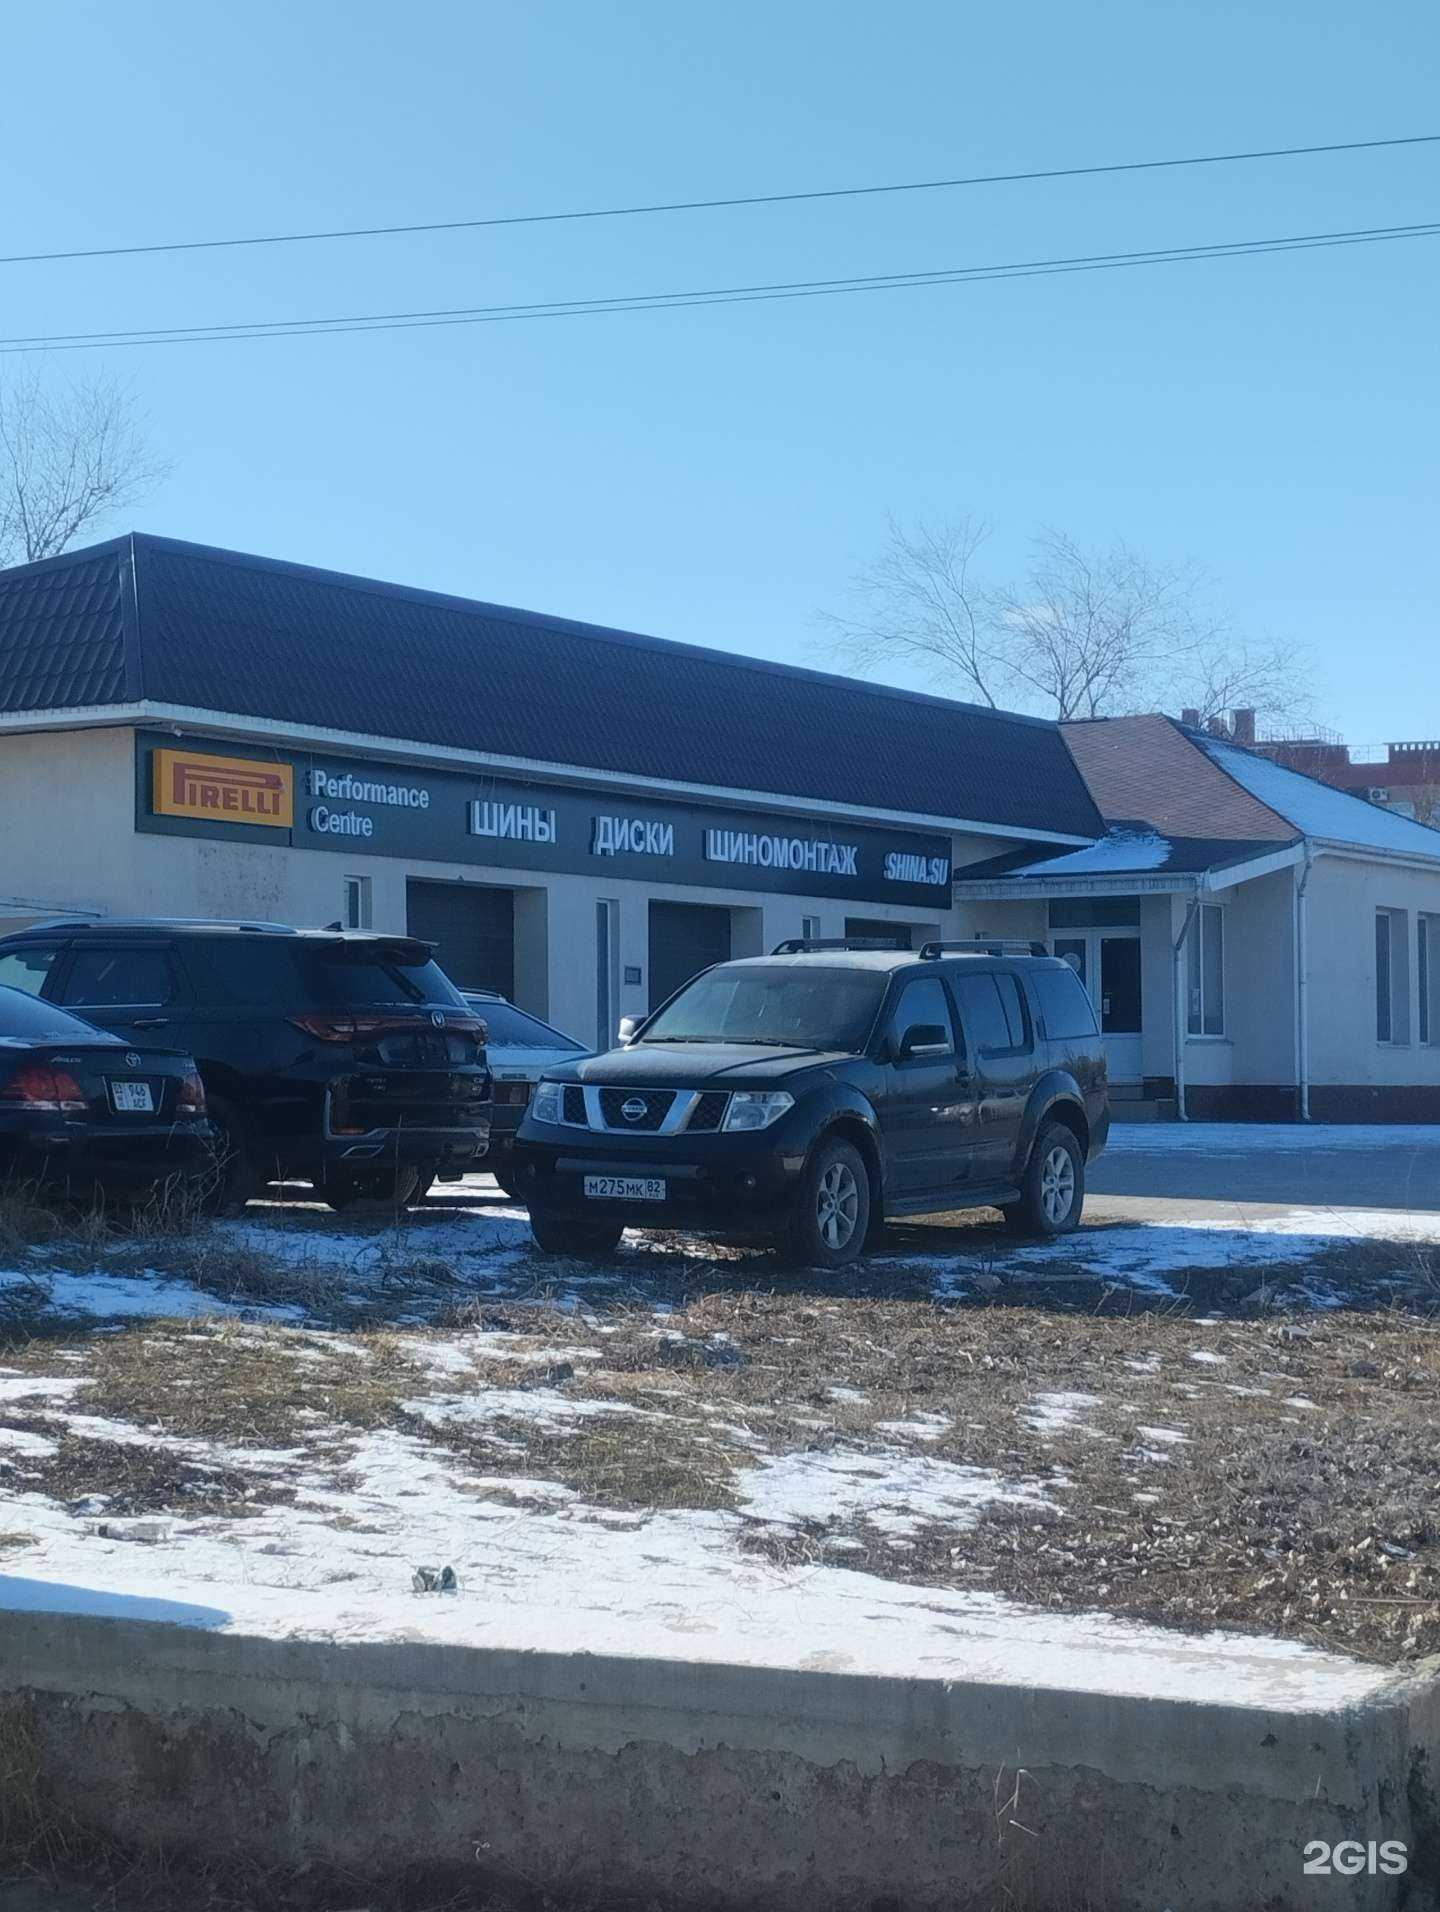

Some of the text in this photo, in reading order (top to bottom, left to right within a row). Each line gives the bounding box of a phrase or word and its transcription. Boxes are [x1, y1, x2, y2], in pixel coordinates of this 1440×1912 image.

[173, 762, 283, 815] PIRELLI
[312, 769, 429, 808] Performance
[312, 806, 373, 836] Centre
[471, 800, 858, 876] ШИНЫ ДИСКИ ШИНОМОНТАЖ
[885, 852, 949, 886] SHINA.SU
